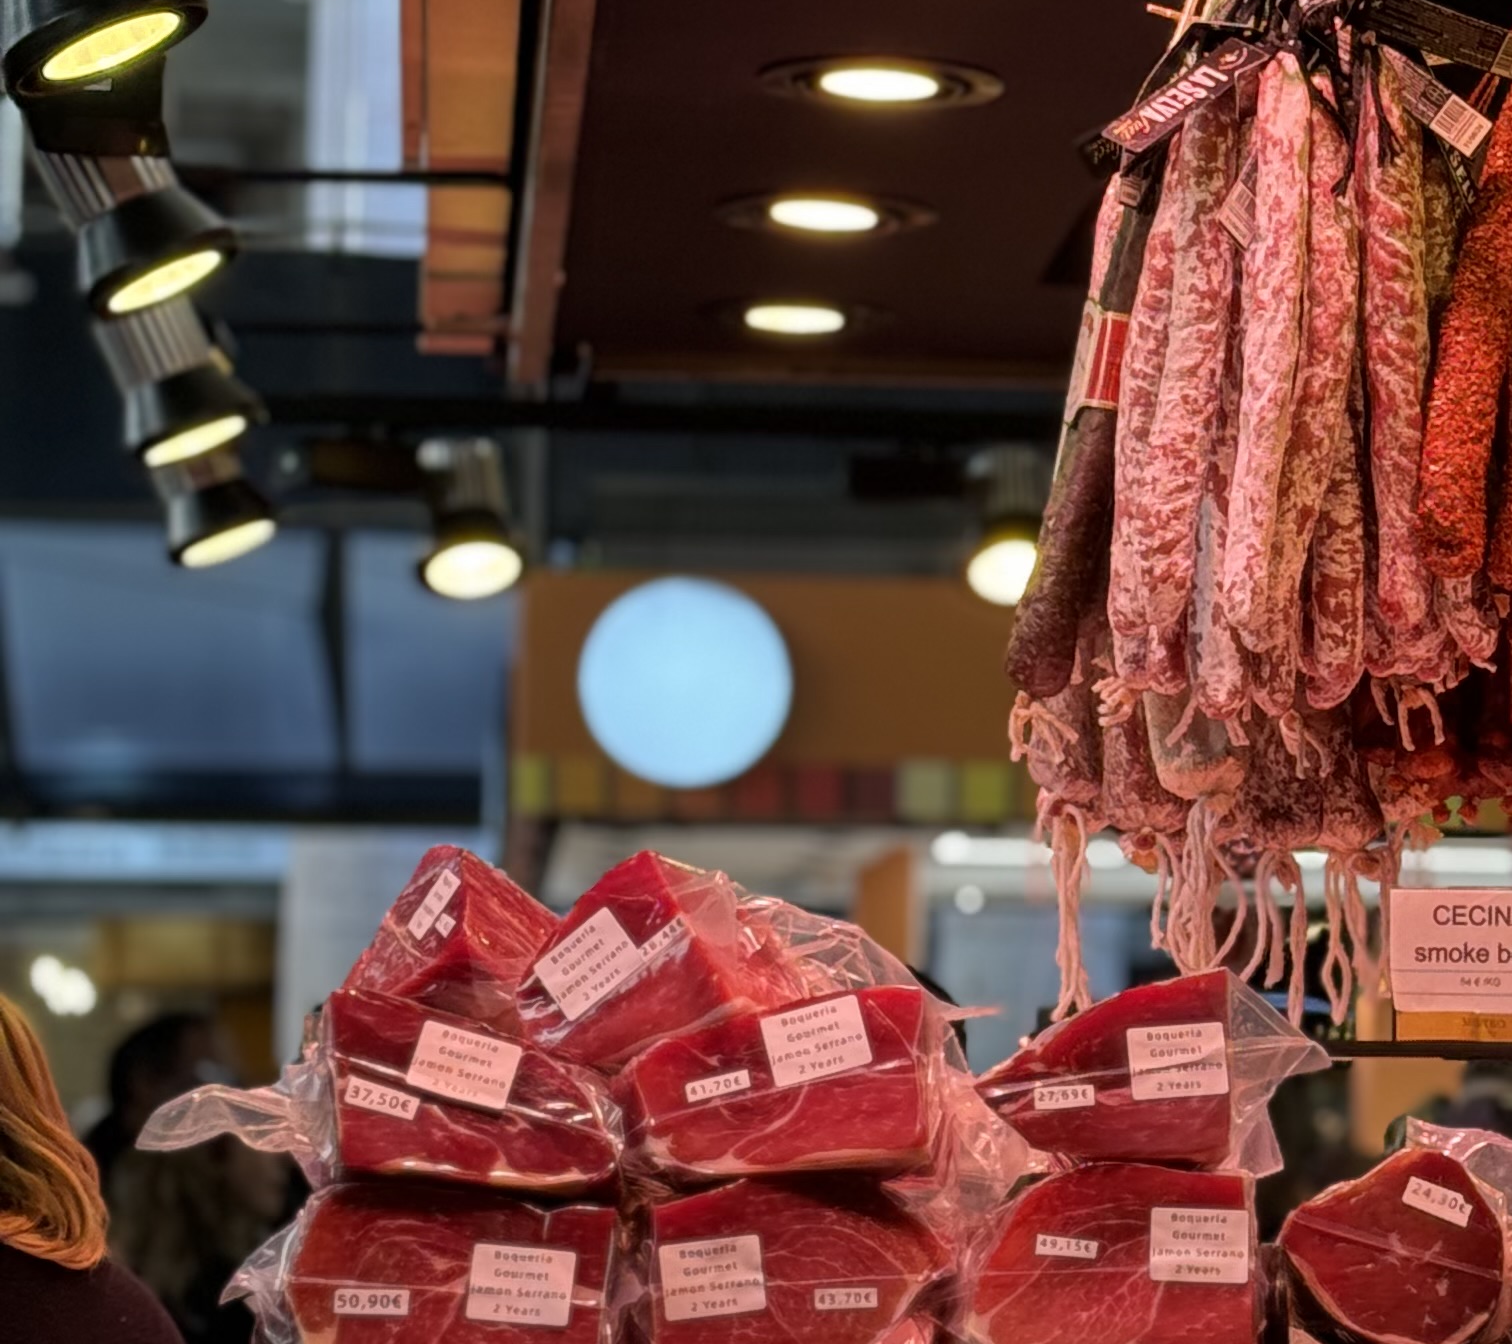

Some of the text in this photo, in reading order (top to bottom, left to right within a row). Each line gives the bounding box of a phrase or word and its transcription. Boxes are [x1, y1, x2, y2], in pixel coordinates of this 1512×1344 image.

[562, 939, 605, 976] Gourmet
[1414, 942, 1489, 963] smoke
[787, 1022, 839, 1042] Gourmet
[439, 1047, 492, 1068] Gourmet
[1150, 1047, 1202, 1058] Gourmet
[351, 1085, 412, 1112] 37,50€
[1173, 1231, 1225, 1240] Gourmet
[494, 1269, 549, 1280] Gourmet
[683, 1263, 737, 1277] Gourmet
[338, 1294, 402, 1310] 50,90€
